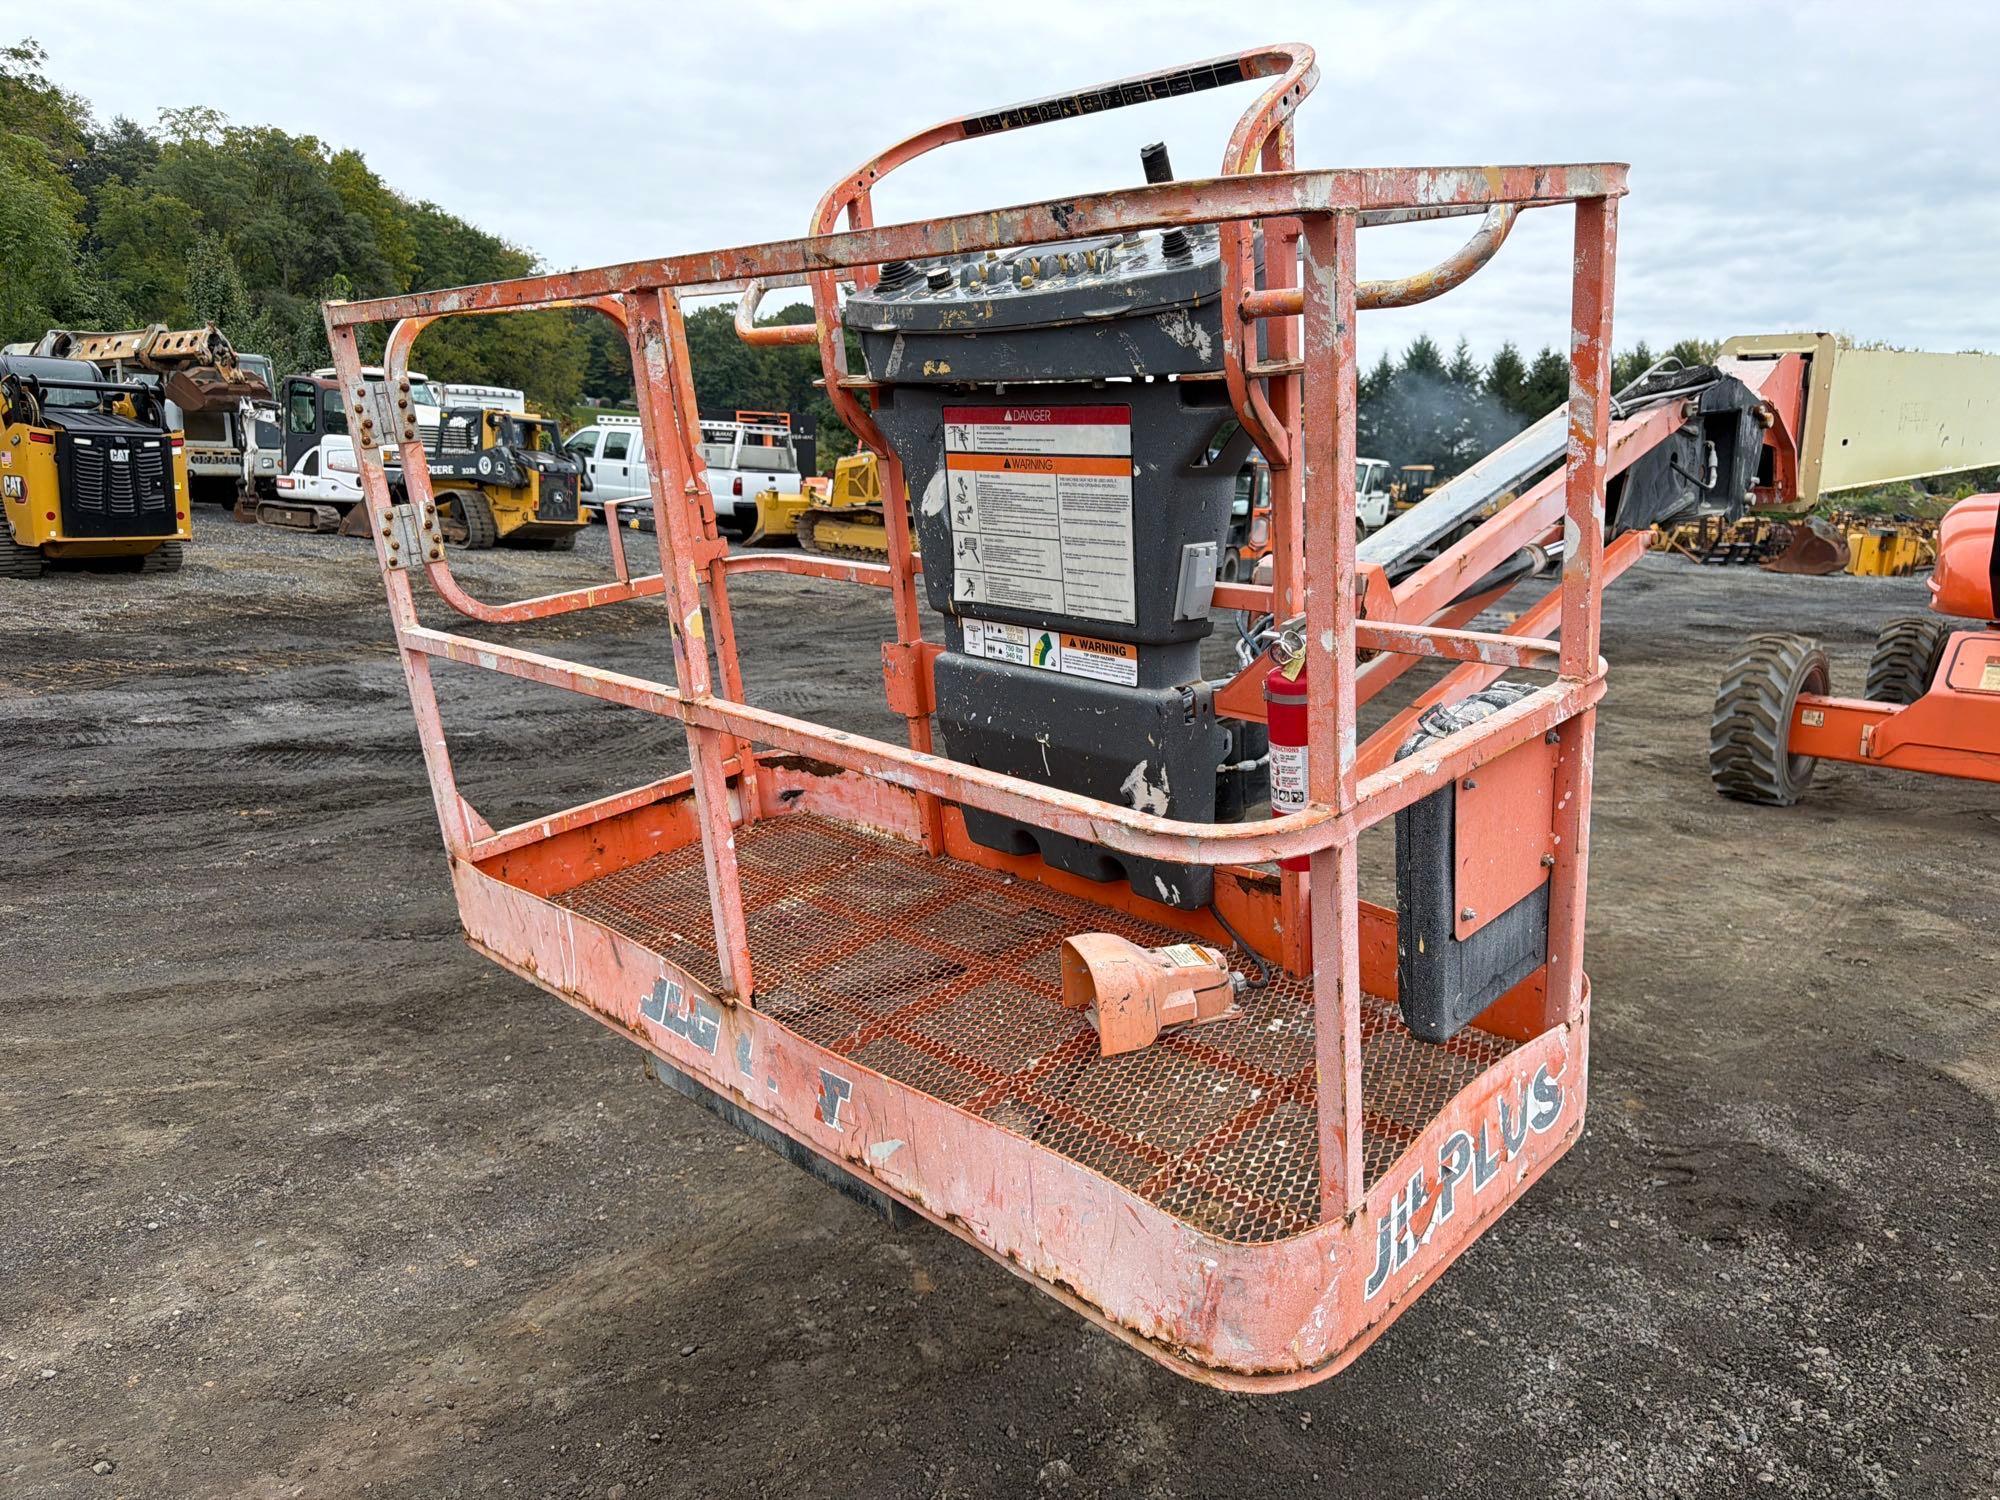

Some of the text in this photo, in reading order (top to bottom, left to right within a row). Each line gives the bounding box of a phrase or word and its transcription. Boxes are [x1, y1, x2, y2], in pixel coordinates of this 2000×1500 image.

[1013, 409, 1051, 421] DANGER
[110, 449, 130, 462] CAT
[427, 464, 454, 475] DEERE
[1011, 458, 1053, 471] WARNING
[3, 475, 22, 497] CAT
[1079, 639, 1127, 657] WARNING
[637, 974, 722, 1057] JLG
